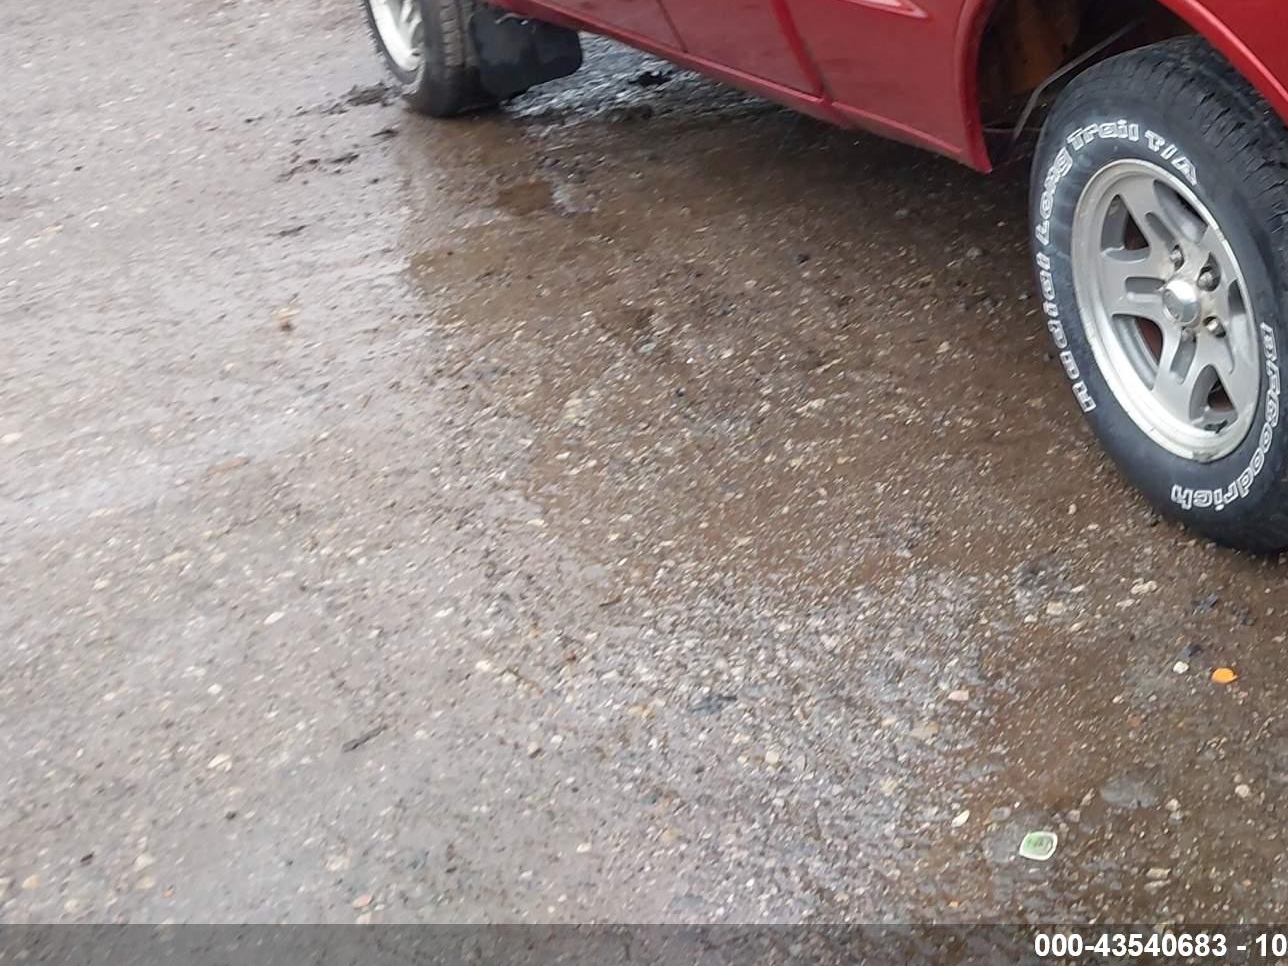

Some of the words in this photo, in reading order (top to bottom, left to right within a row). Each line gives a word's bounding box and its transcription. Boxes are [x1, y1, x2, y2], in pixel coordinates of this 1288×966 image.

[1066, 119, 1140, 151] Trail
[1144, 129, 1198, 186] T/A
[1035, 146, 1073, 246] Long
[1035, 251, 1097, 413] Radial
[1170, 321, 1281, 511] BFGoodrich
